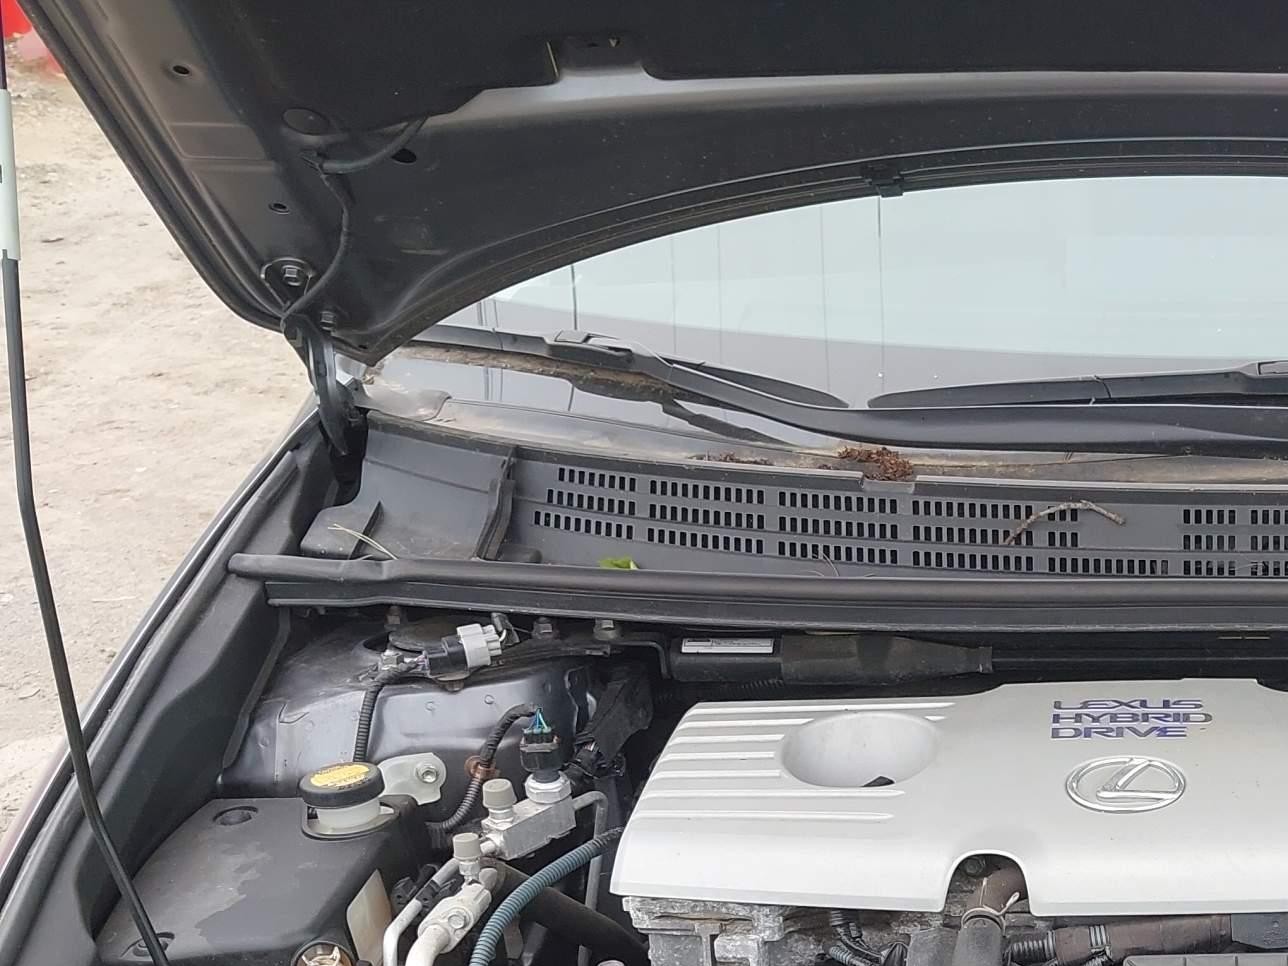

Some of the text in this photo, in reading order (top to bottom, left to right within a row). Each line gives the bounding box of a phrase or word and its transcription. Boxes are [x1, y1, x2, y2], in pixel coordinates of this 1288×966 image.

[1053, 699, 1203, 710] LEXUS
[1051, 712, 1213, 724] HYBRID
[1050, 726, 1188, 739] DRIVE
